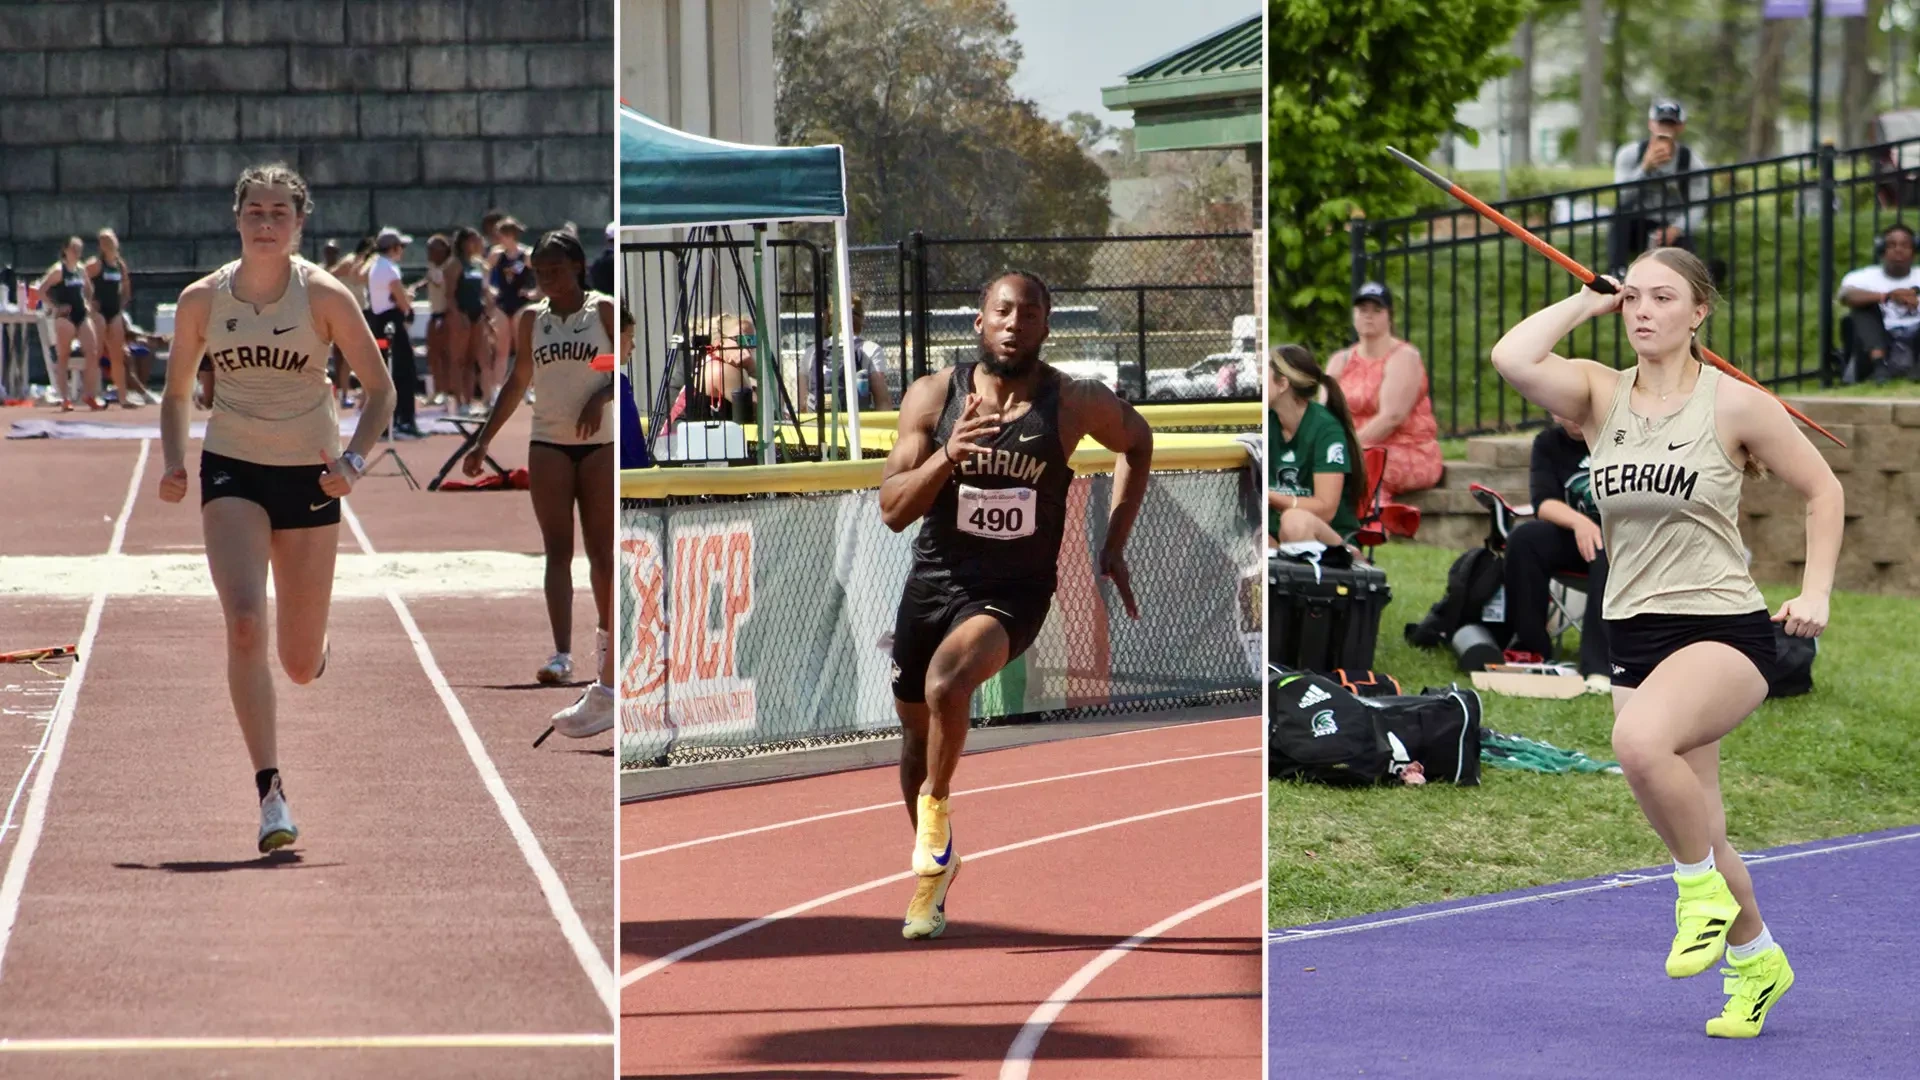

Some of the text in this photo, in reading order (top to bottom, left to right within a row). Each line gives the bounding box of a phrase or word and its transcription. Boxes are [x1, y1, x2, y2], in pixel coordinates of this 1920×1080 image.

[213, 345, 310, 373] FERRUM
[533, 341, 599, 368] FERRUM
[952, 449, 1048, 485] ERRUM
[1594, 463, 1699, 501] FERRUM
[968, 507, 1023, 532] 490
[672, 532, 751, 684] UCP
